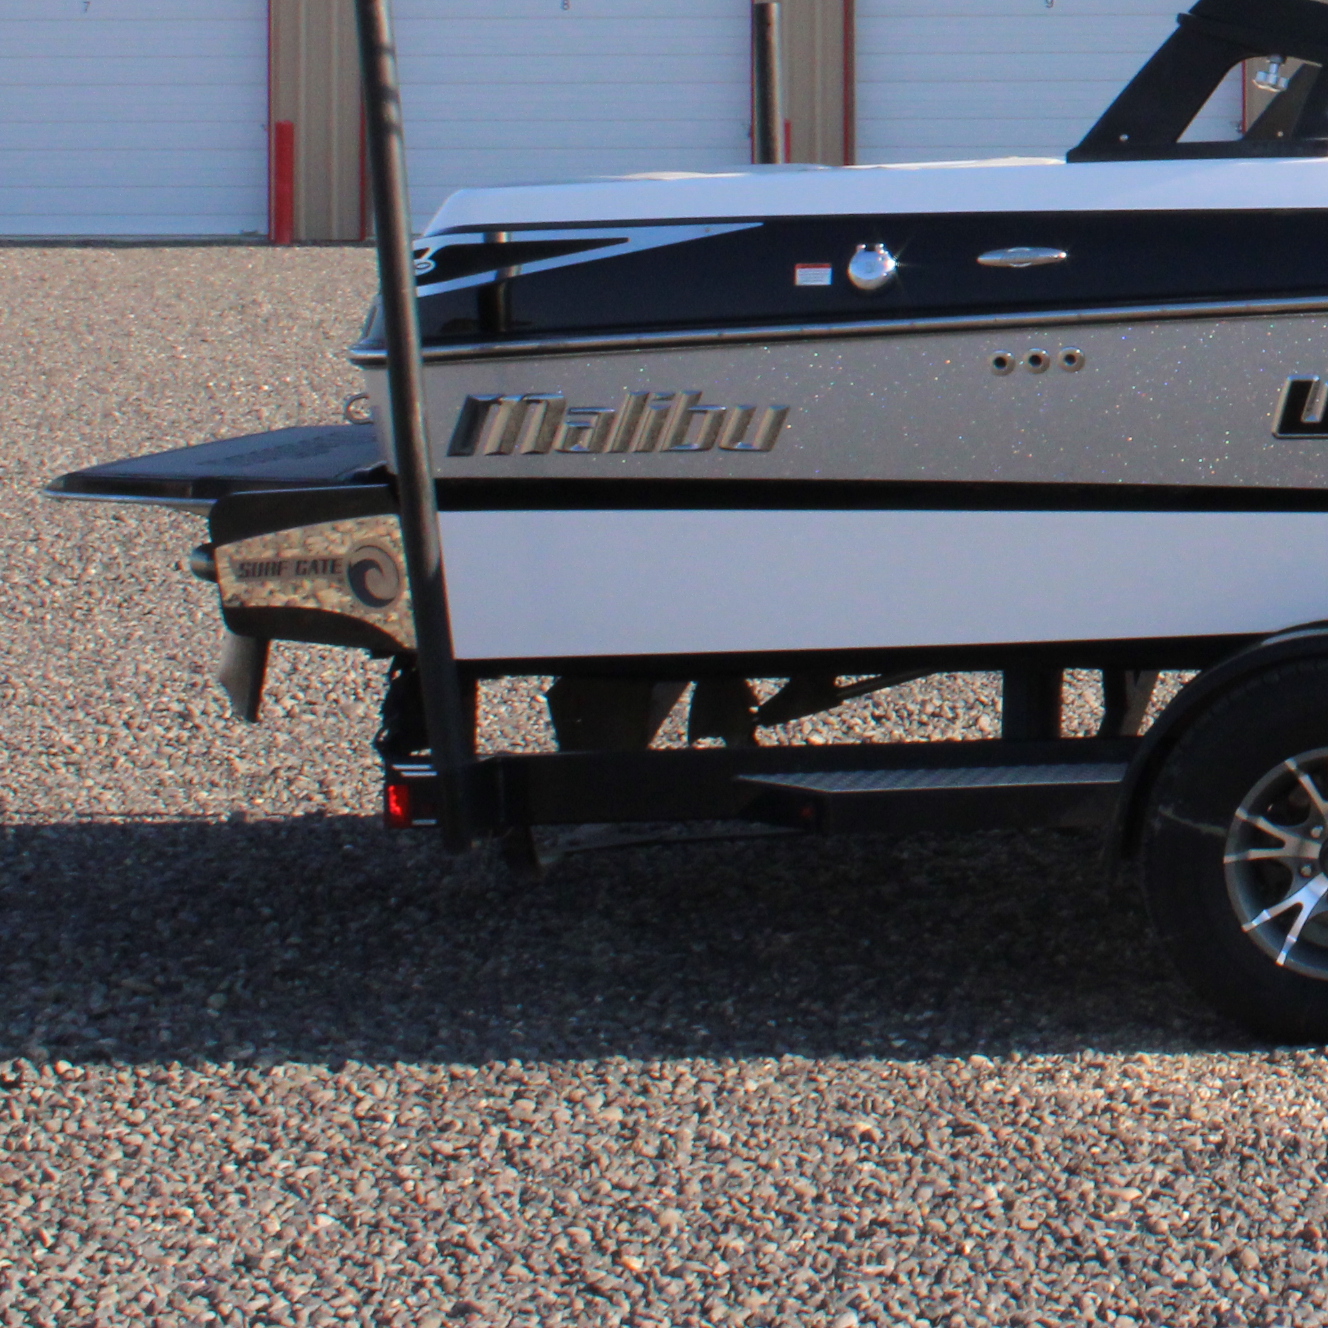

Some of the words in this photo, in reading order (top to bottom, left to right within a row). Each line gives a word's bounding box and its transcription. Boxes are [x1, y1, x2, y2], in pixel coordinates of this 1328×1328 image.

[82, 1, 91, 13] 7
[237, 559, 289, 579] SURF
[294, 557, 343, 576] GATE
